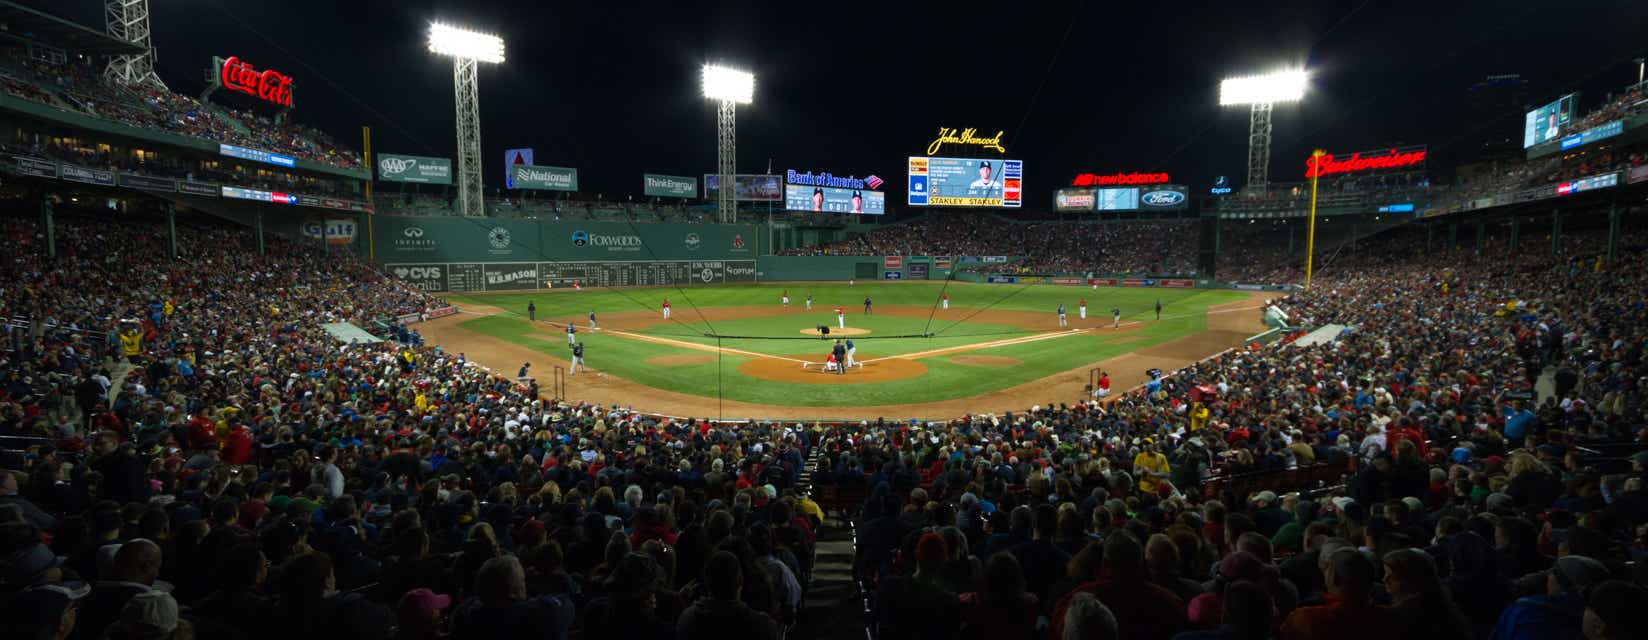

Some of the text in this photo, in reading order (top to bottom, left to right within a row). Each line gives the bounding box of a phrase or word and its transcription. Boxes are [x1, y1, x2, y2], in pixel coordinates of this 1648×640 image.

[928, 126, 1005, 156] John Hancock
[383, 158, 405, 171] AAA
[1304, 149, 1425, 178] Budweiser
[530, 170, 572, 184] National
[648, 177, 694, 191] ThinkEnergy
[787, 169, 864, 190] Bank of America
[1094, 174, 1118, 185] new
[1118, 172, 1169, 185] balance
[1150, 193, 1177, 204] Ford
[304, 222, 353, 236] Gulf
[410, 266, 441, 279] CVS
[408, 280, 441, 291] ealth
